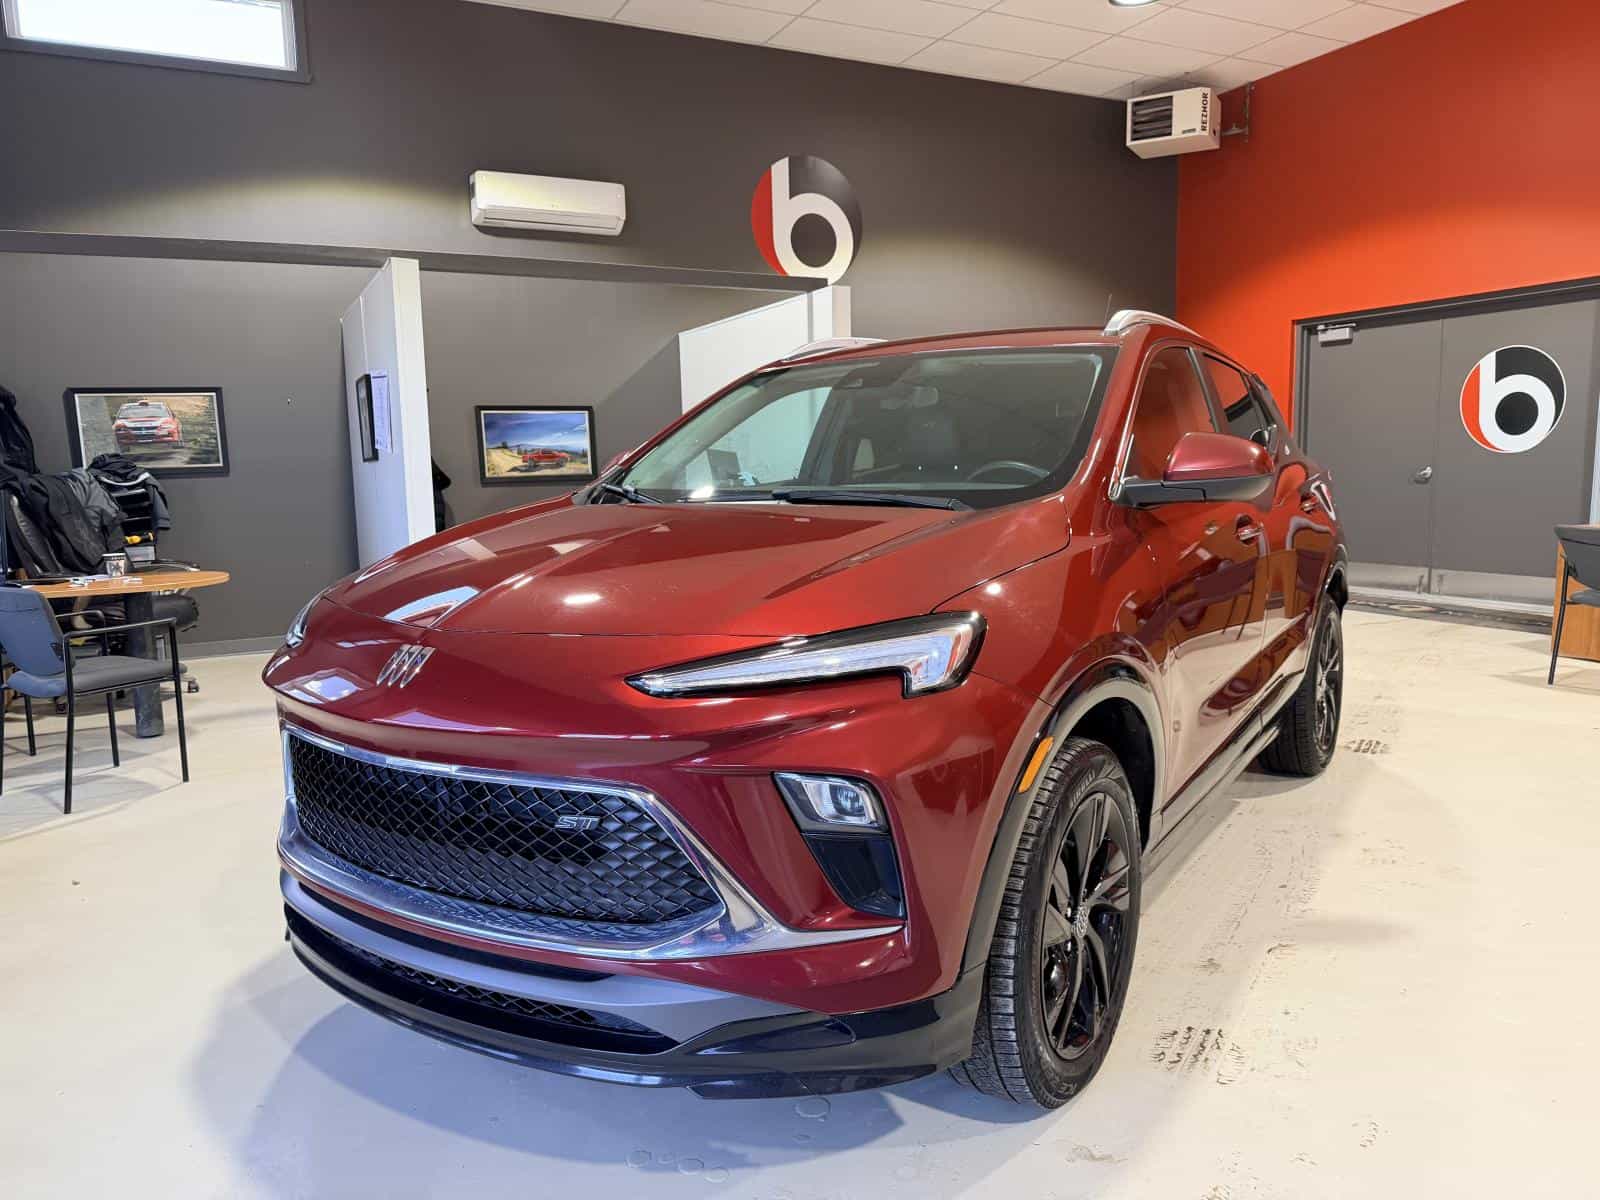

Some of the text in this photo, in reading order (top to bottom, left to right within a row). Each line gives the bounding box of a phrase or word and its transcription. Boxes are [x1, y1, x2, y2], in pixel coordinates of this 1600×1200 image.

[1200, 92, 1209, 131] REZNOR
[771, 155, 854, 286] b
[1479, 350, 1556, 453] b
[554, 815, 600, 830] ST
